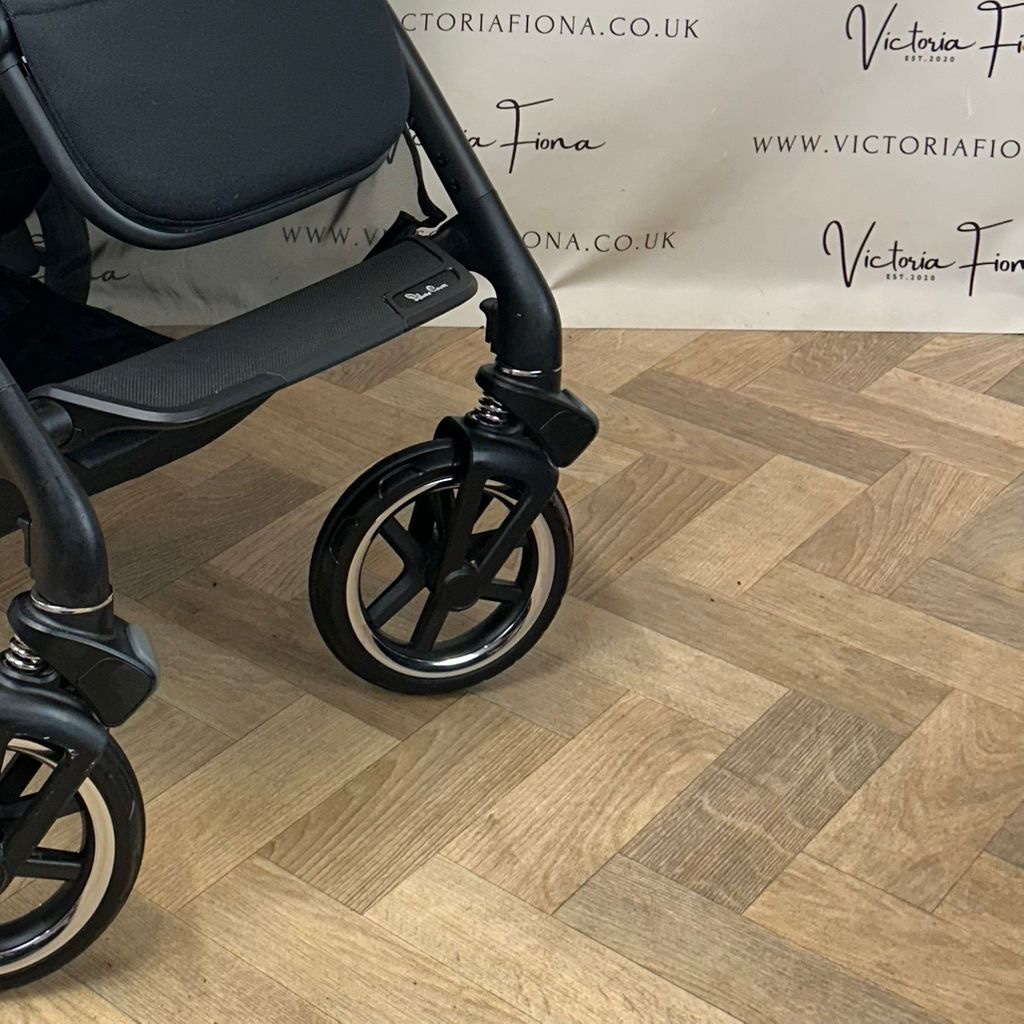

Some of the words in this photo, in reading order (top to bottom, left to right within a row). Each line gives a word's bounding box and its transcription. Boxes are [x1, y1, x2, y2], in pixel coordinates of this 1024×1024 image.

[845, 2, 976, 71] Victoria
[905, 55, 955, 63] EST.2020
[496, 98, 606, 174] Fiona
[753, 135, 1022, 158] WWW.VICTORIAFIO
[823, 220, 956, 288] Victoria
[886, 273, 936, 282] EST.2020
